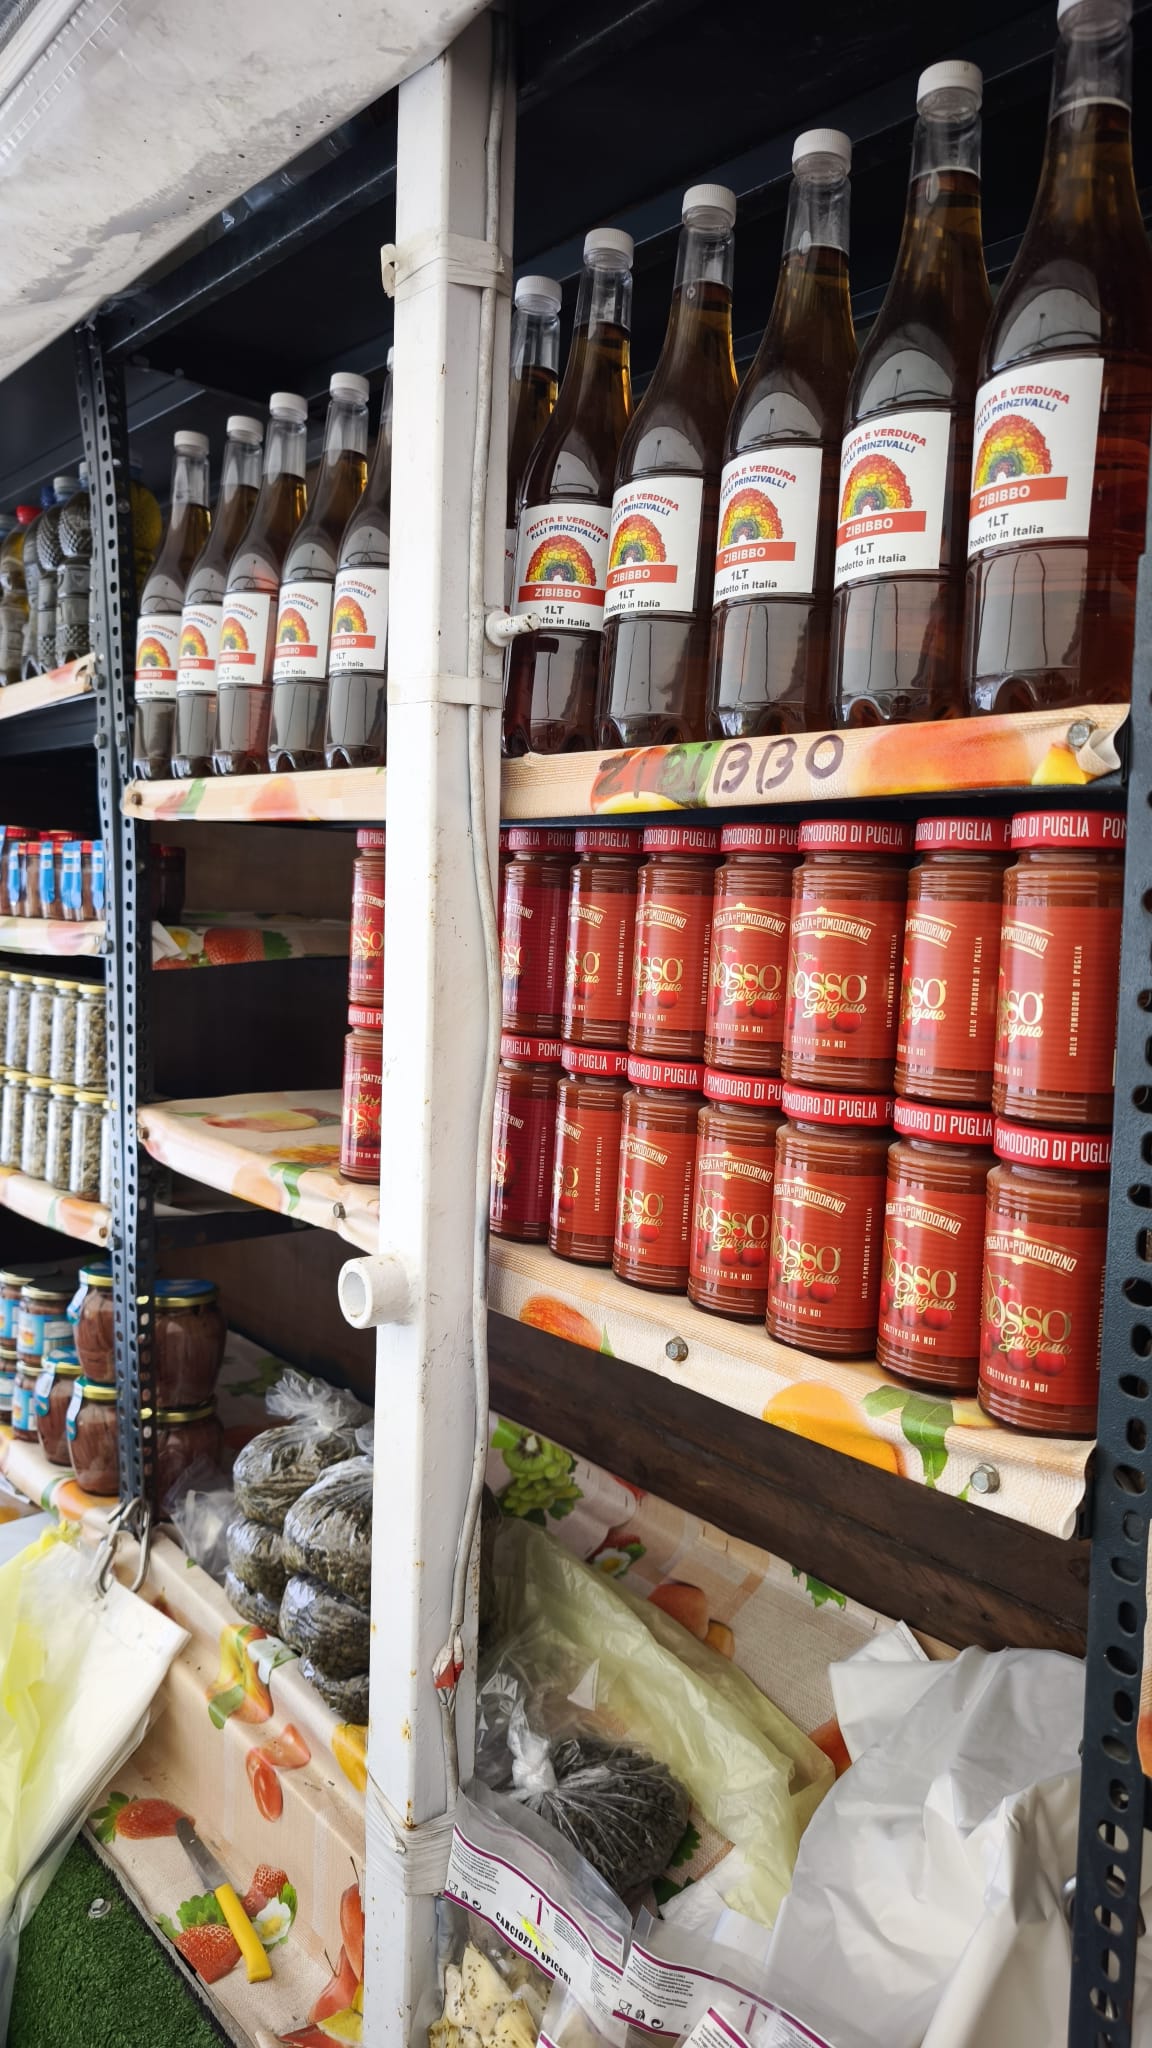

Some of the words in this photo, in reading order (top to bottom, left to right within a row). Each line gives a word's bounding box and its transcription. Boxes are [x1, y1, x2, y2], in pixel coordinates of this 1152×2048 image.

[1001, 390, 1006, 398] E
[1010, 385, 1070, 404] VERDURA
[992, 397, 1058, 415] PRINZIVALLI
[856, 439, 916, 455] PRINZIVALLI
[865, 432, 870, 440] E
[873, 428, 927, 447] VERDURA
[734, 475, 787, 489] PRINZIVALLI
[749, 464, 797, 484] VERDURA
[636, 493, 680, 511] VERDURA
[978, 484, 1031, 509] ZIBIBBO
[623, 502, 670, 516] PRINZIVALLI
[526, 516, 554, 537] FRUTTA
[567, 516, 610, 540] VERDURA
[846, 517, 894, 538] ZIBIBBO
[988, 512, 1009, 528] 1LT
[549, 524, 601, 544] PRINZIVALLI
[1000, 529, 1009, 539] in
[1012, 524, 1044, 536] Italia
[724, 547, 766, 564] ZIBIBBO
[854, 542, 874, 556] 1LT
[866, 556, 875, 566] in
[878, 552, 906, 564] Italia
[612, 569, 651, 584] ZIBIBBO
[731, 569, 749, 581] 1LT
[534, 588, 581, 599] ZIBIBBO
[619, 588, 635, 599] 1LT
[741, 582, 749, 590] in
[752, 580, 777, 589] Italia
[544, 605, 565, 615] 1LT
[628, 601, 635, 609] in
[637, 599, 661, 608] Italia
[556, 617, 565, 625] in
[567, 618, 591, 628] Italia
[348, 660, 364, 668] Italia
[800, 825, 846, 842] POMODORO
[850, 825, 862, 842] DI
[866, 826, 903, 846] PUGLIA
[936, 822, 946, 840] DI
[949, 822, 992, 842] PUGLIA
[1028, 816, 1039, 838] DI
[1042, 816, 1090, 838] PUGLIA
[598, 832, 630, 848] PUGLIA
[670, 830, 680, 846] DI
[682, 830, 716, 848] PUGLIA
[722, 828, 761, 846] POMODORO
[765, 828, 776, 845] DI
[736, 912, 786, 934] POMODORINO
[816, 916, 872, 941] POMODORINO
[1073, 945, 1083, 975] PUGLIA
[724, 979, 782, 1006] Gargano
[802, 991, 867, 1019] Gargano
[752, 1025, 764, 1034] NOI
[506, 1040, 531, 1056] PUGLIA
[822, 1038, 831, 1048] DA
[834, 1038, 847, 1049] NOI
[578, 1053, 607, 1071] PUGLIA
[652, 1066, 662, 1081] DI
[664, 1067, 698, 1085] PUGLIA
[707, 1077, 752, 1098] POMODORO
[754, 1080, 765, 1099] DI
[824, 1098, 834, 1116] DI
[838, 1099, 878, 1120] PUGLIA
[934, 1115, 946, 1133] DI
[950, 1116, 992, 1137] PUGLIA
[996, 1130, 1048, 1158] POMODORO
[1053, 1139, 1066, 1161] DI
[723, 1160, 774, 1183] POMODORINO
[794, 1185, 847, 1214] POMODORINO
[906, 1204, 961, 1235] POMODORINO
[712, 1226, 769, 1252] Gargano
[1013, 1238, 1078, 1272] POMODORINO
[730, 1270, 739, 1280] DA
[742, 1272, 752, 1281] NOI
[780, 1256, 841, 1288] Gargano
[894, 1280, 956, 1313] Gargano
[799, 1306, 808, 1316] DA
[810, 1308, 822, 1318] NOI
[912, 1332, 921, 1342] DA
[924, 1335, 936, 1346] NOI
[998, 1321, 1072, 1358] Gargano
[986, 1365, 1017, 1386] COLTIVATO
[1020, 1377, 1032, 1390] DA
[1034, 1380, 1048, 1393] NOI
[496, 1912, 532, 1948] CARCIOFI
[541, 1952, 572, 1985] SPICCHI
